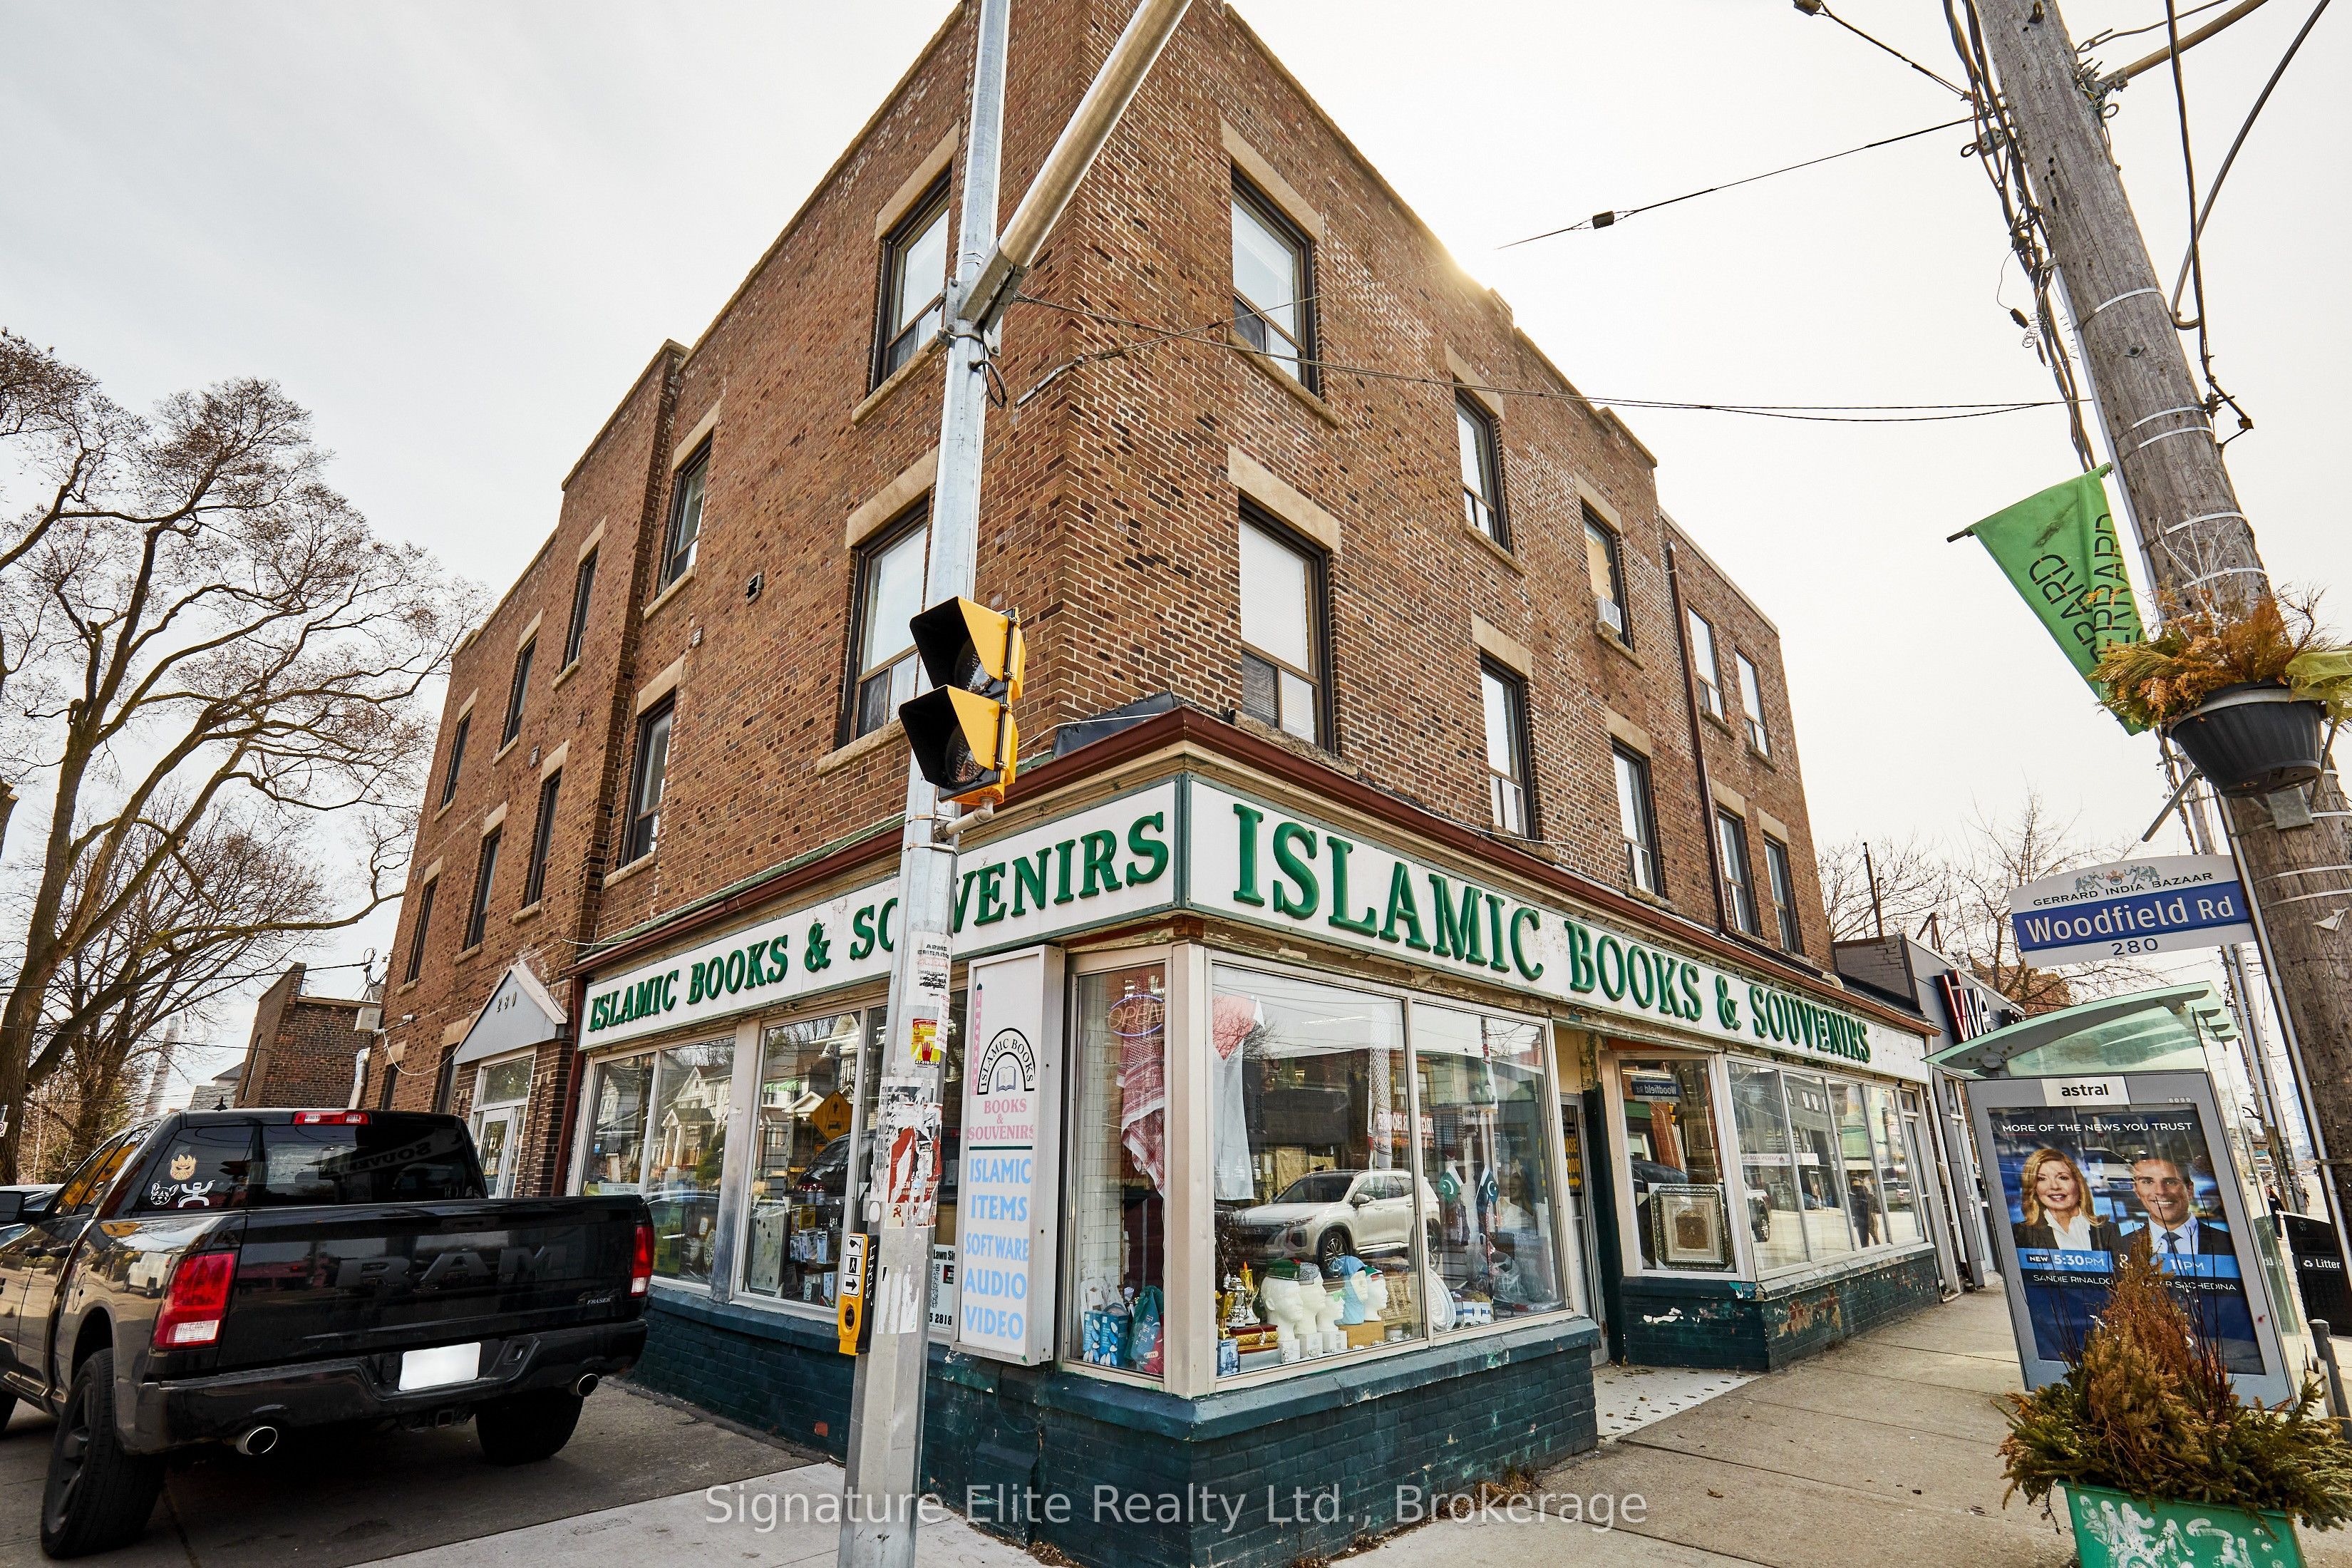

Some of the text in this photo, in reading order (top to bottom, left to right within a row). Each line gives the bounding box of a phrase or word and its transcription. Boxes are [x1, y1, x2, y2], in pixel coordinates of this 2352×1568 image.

[2033, 872, 2213, 906] GERRARD INDIA BAZAAR
[588, 811, 1169, 1032] ISLAMIC BOOKS & SOVENIRS
[2026, 896, 2235, 943] Woodfield Rd
[1233, 803, 1871, 1063] ISLAMIC BOOKS & SOUVENIRS
[2113, 938, 2159, 955] 280
[1108, 1003, 1165, 1028] OPEN
[981, 1038, 1033, 1087] ISLAMIC BOOKS
[2061, 1083, 2109, 1097] astral
[984, 1098, 1027, 1114] BOOKS
[996, 1113, 1004, 1124] &
[2085, 1123, 2120, 1132] NEWS
[968, 1125, 1033, 1140] SOUVENIRS
[969, 1158, 1031, 1184] ISLAMIC
[1567, 1157, 1580, 1173] OOR
[971, 1195, 1027, 1221] ITEMS
[933, 1249, 947, 1261] Lawn
[2053, 1254, 2105, 1267] 5:30PM
[2170, 1259, 2204, 1271] 11PM
[2315, 1258, 2341, 1269] Litter
[335, 1246, 568, 1289] RAM
[964, 1268, 1027, 1299] AUDIO
[2033, 1274, 2068, 1283] SANDIE
[964, 1304, 1024, 1340] VIDEO
